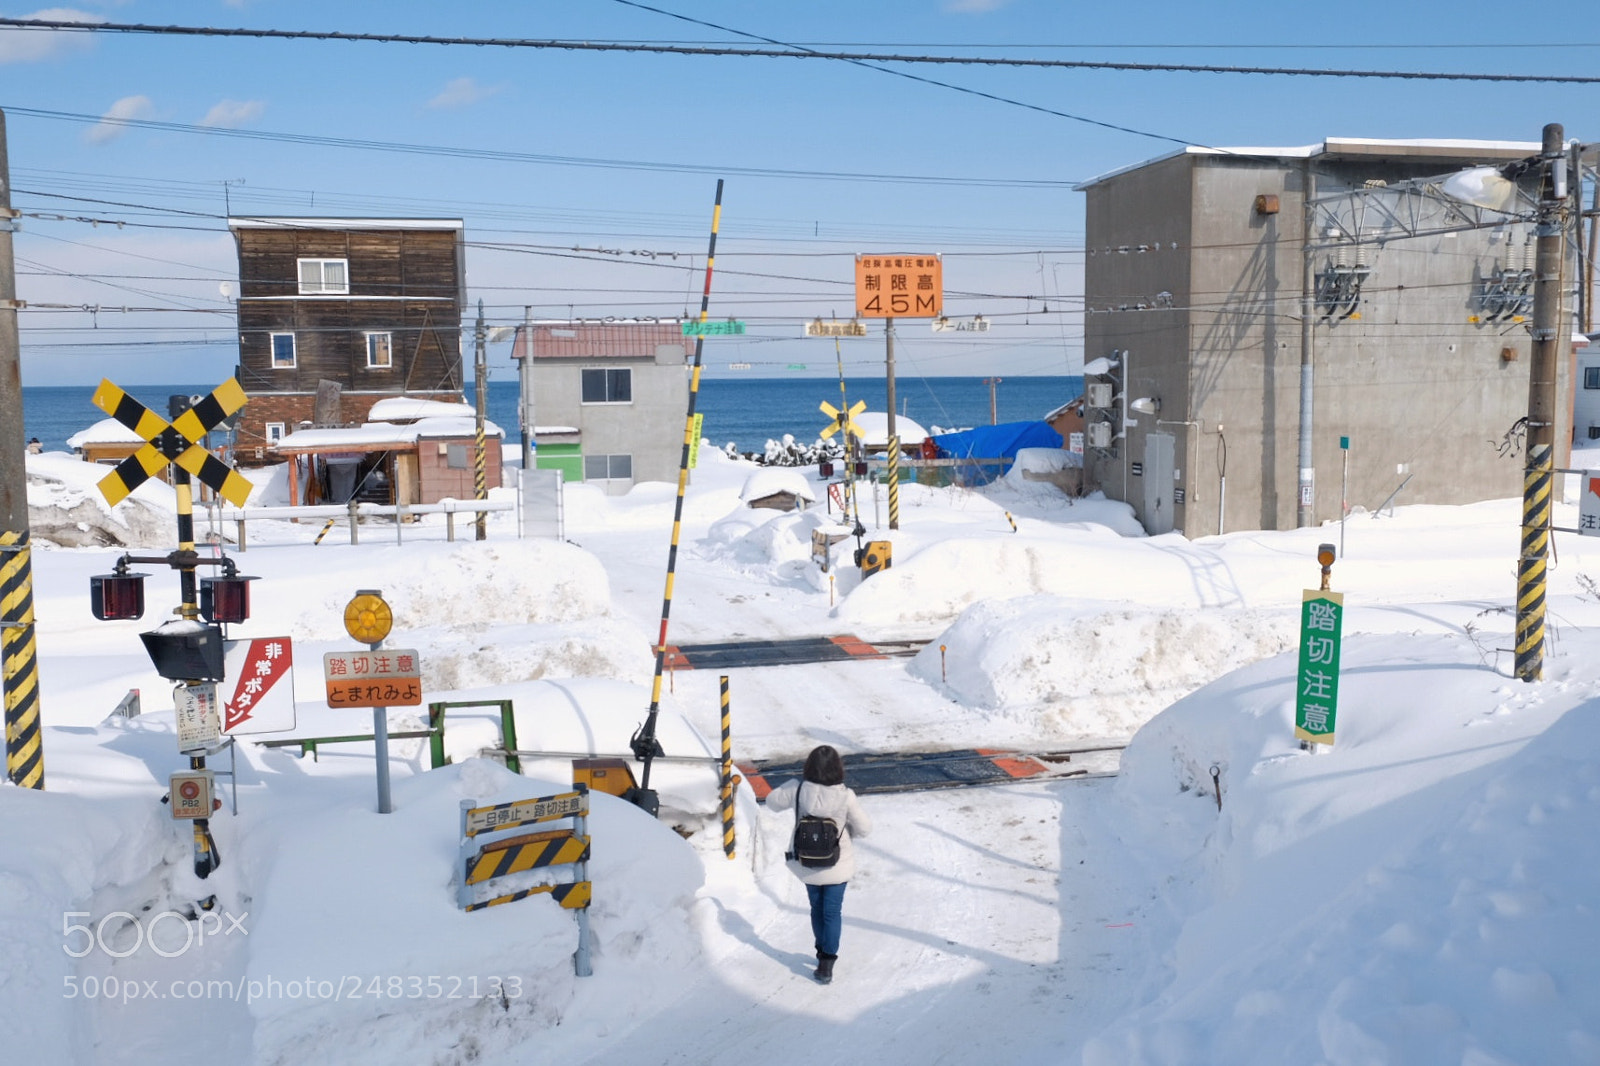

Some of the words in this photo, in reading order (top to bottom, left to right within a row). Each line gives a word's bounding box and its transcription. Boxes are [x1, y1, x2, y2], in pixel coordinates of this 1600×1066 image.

[864, 273, 934, 291] 制限高
[863, 293, 935, 314] 4.5M
[685, 322, 744, 335] アンテナ注意
[1581, 513, 1600, 530] 注
[329, 655, 414, 676] 踏切注意
[1301, 602, 1337, 733] 踏切注意
[228, 642, 283, 722] 非常ボタン
[329, 683, 418, 702] とまれみよ
[182, 799, 200, 807] PB2
[472, 797, 580, 827] 一旦停止・踏切注意
